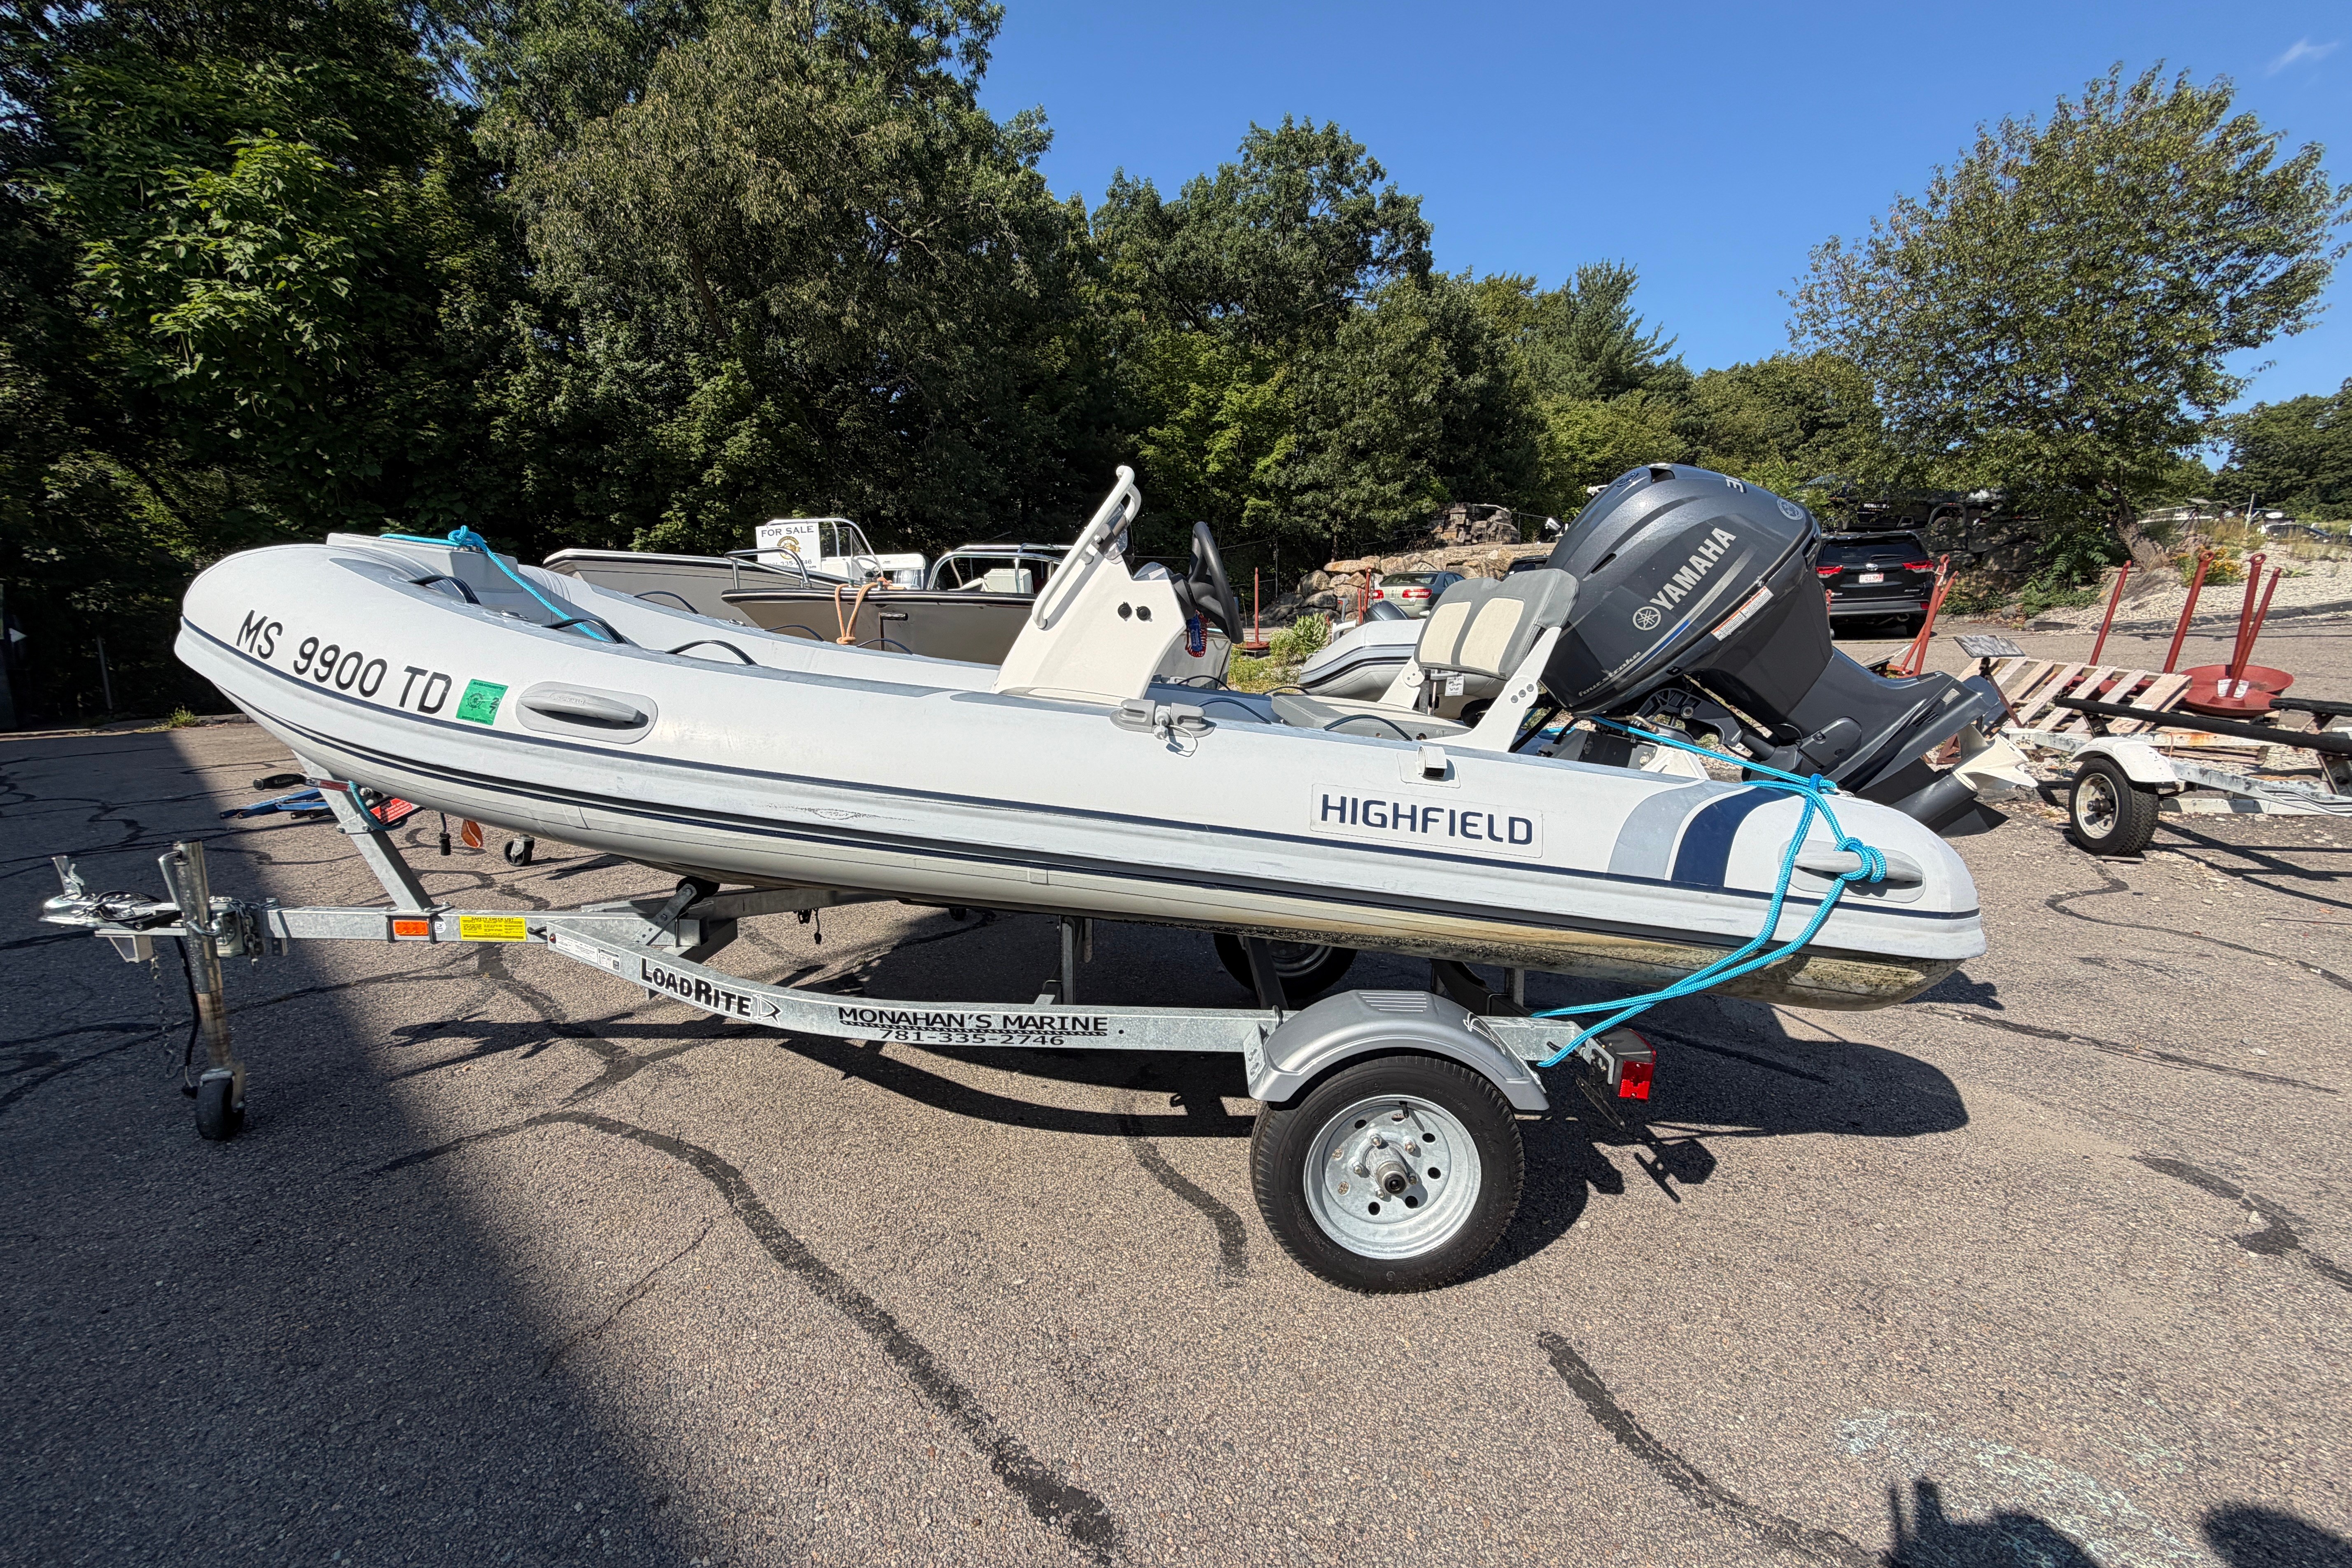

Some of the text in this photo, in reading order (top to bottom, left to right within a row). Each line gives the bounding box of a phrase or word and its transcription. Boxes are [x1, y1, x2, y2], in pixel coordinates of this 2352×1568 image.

[761, 526, 814, 537] FOR SALE
[1650, 528, 1736, 610] YAMAHA
[236, 609, 452, 714] MS 9900 TD
[1321, 794, 1533, 845] HIGHFIELD
[838, 1007, 1108, 1031] MONAHAN'S MARINE
[880, 1029, 1064, 1046] 781-335-2746
